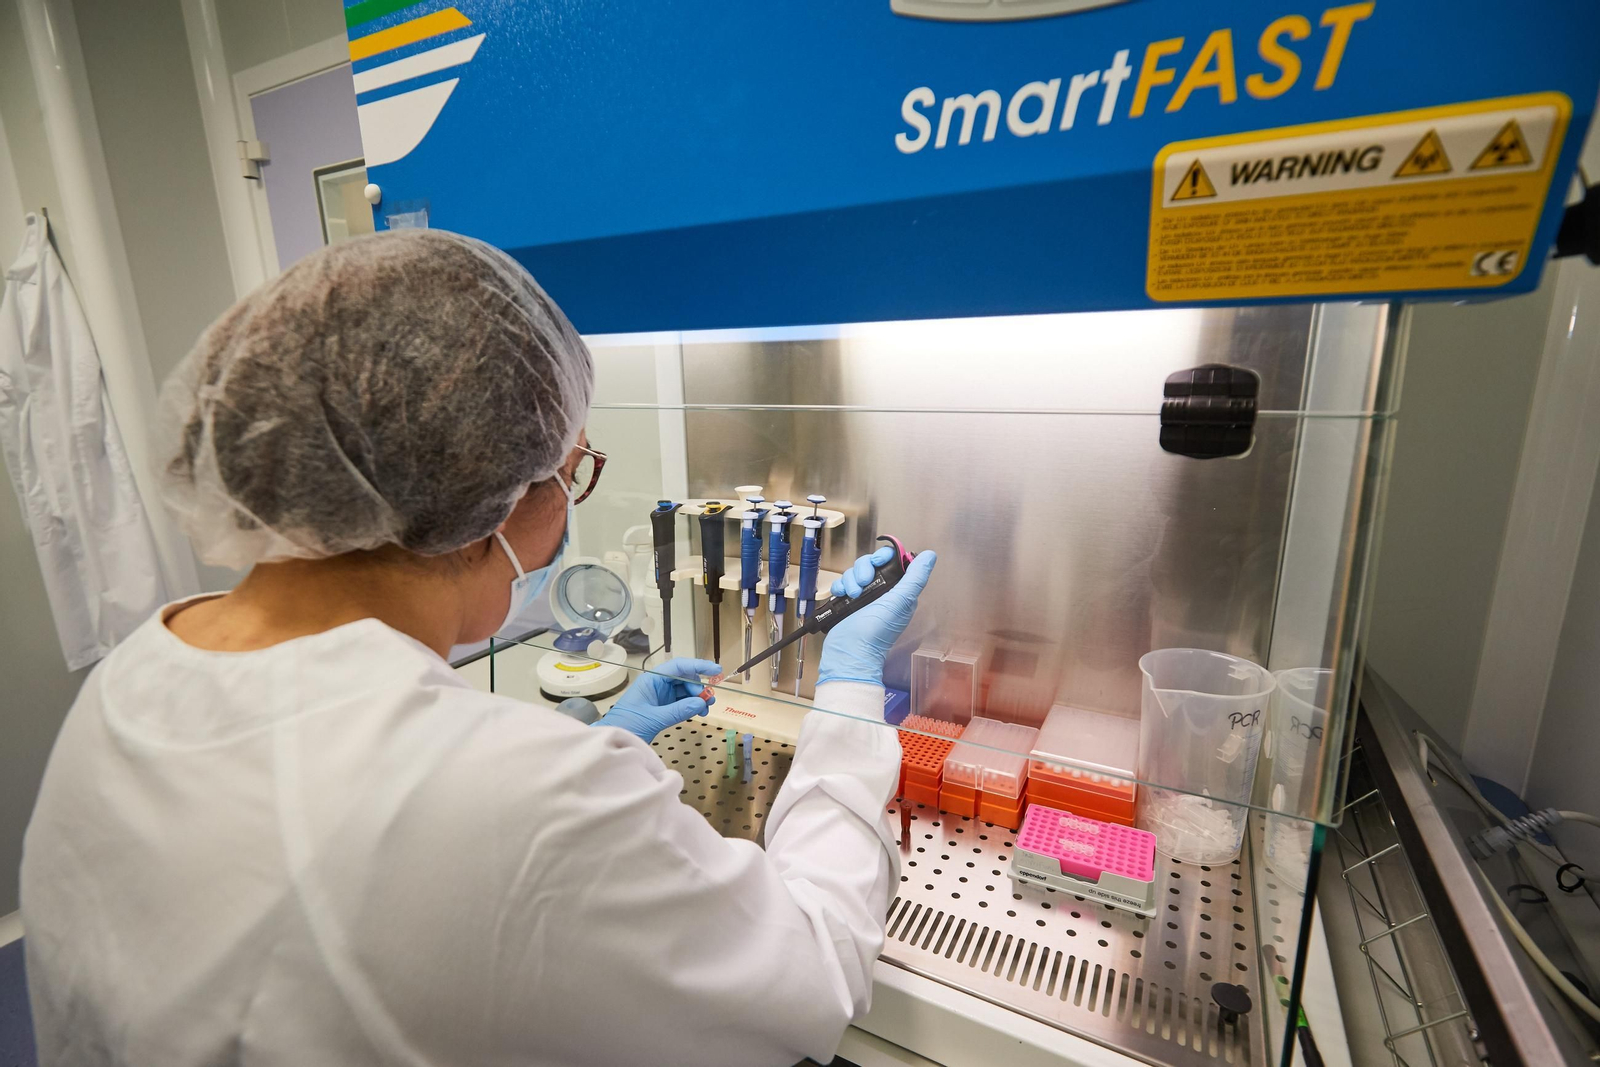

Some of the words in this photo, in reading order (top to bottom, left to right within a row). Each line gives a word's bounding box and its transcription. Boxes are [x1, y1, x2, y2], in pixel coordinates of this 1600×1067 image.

[894, 2, 1376, 154] SmartFAST
[1229, 145, 1385, 188] WARNING
[725, 706, 756, 718] Thermo
[1228, 709, 1261, 730] PCR
[1019, 869, 1047, 881] eppendorf
[1098, 891, 1110, 899] side
[1122, 898, 1141, 908] freeze
